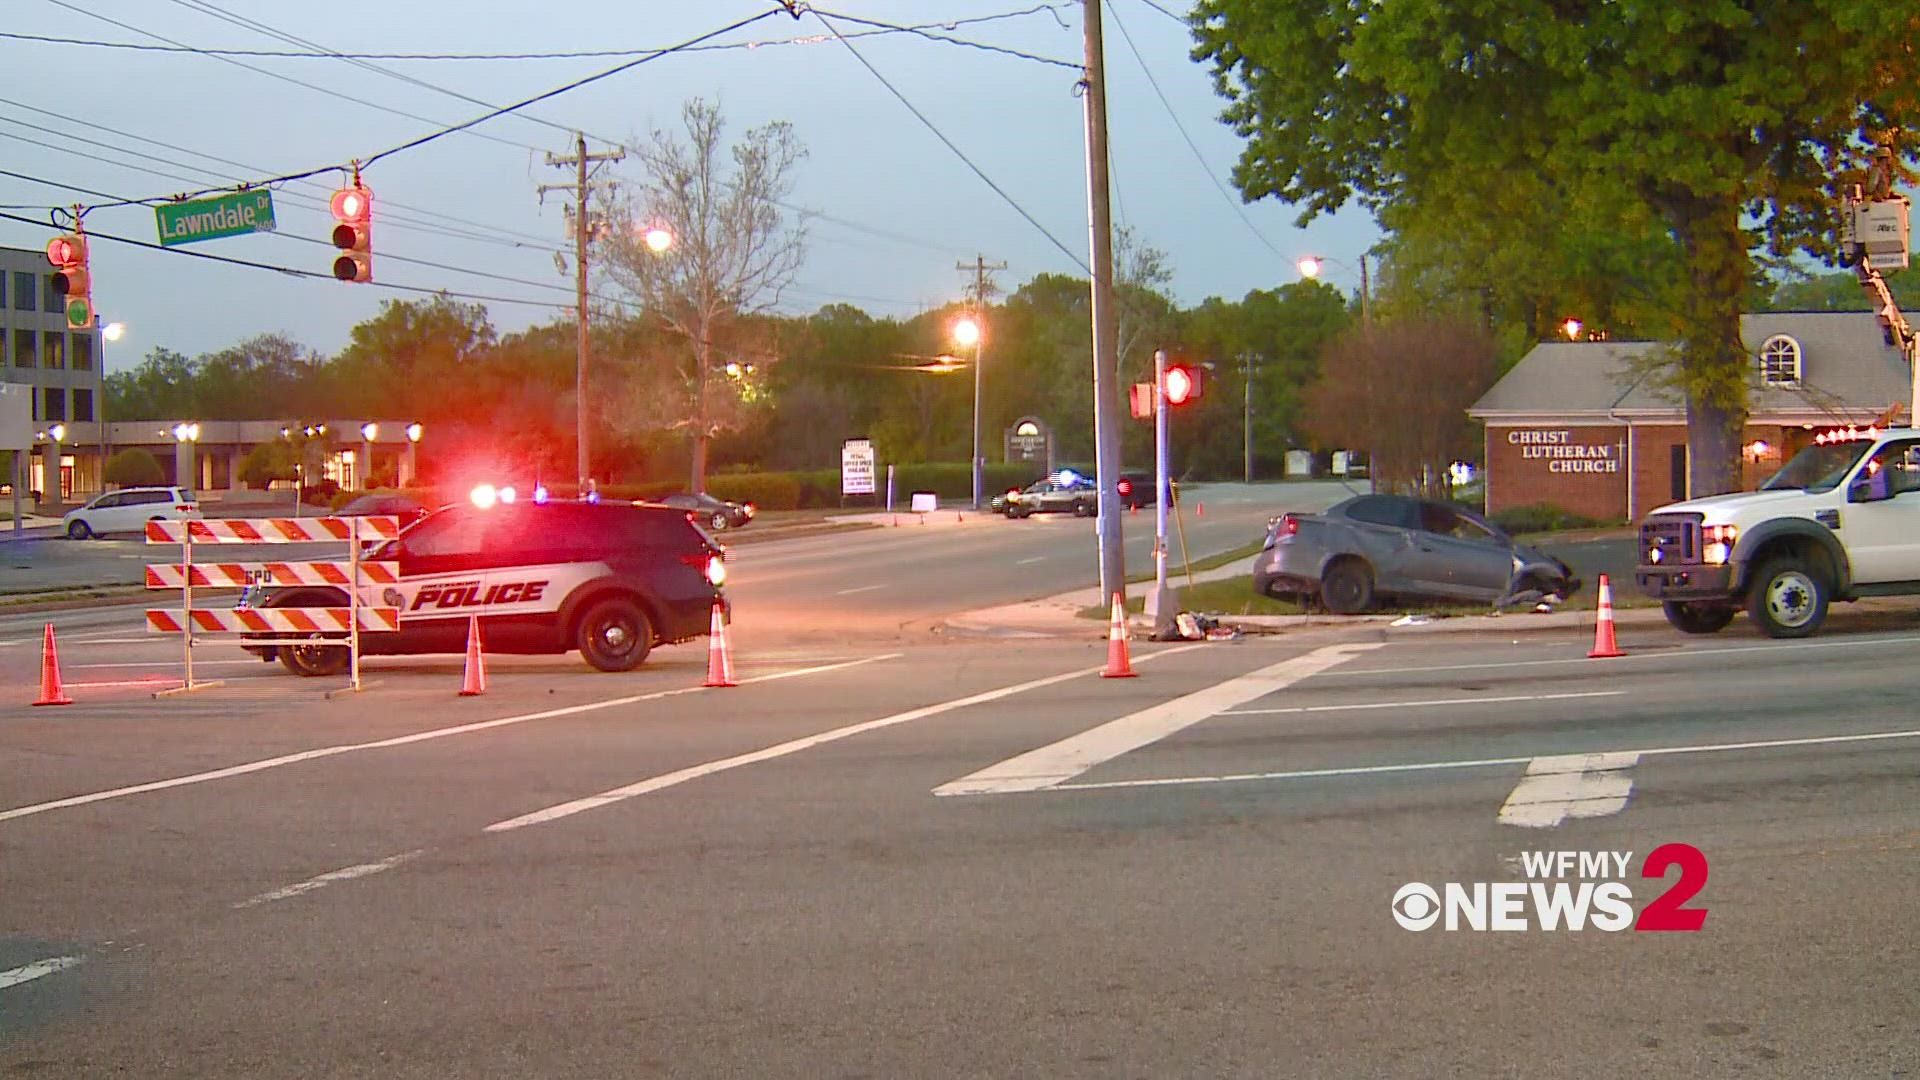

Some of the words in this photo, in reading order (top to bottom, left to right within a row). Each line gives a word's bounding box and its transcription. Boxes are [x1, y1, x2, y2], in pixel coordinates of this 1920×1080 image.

[160, 203, 256, 239] Lawndale
[257, 195, 270, 209] Dr
[1508, 430, 1569, 444] CHRIST
[1522, 445, 1609, 459] LUTHERAN
[1548, 459, 1617, 473] CHURCH
[410, 580, 550, 611] POLICE
